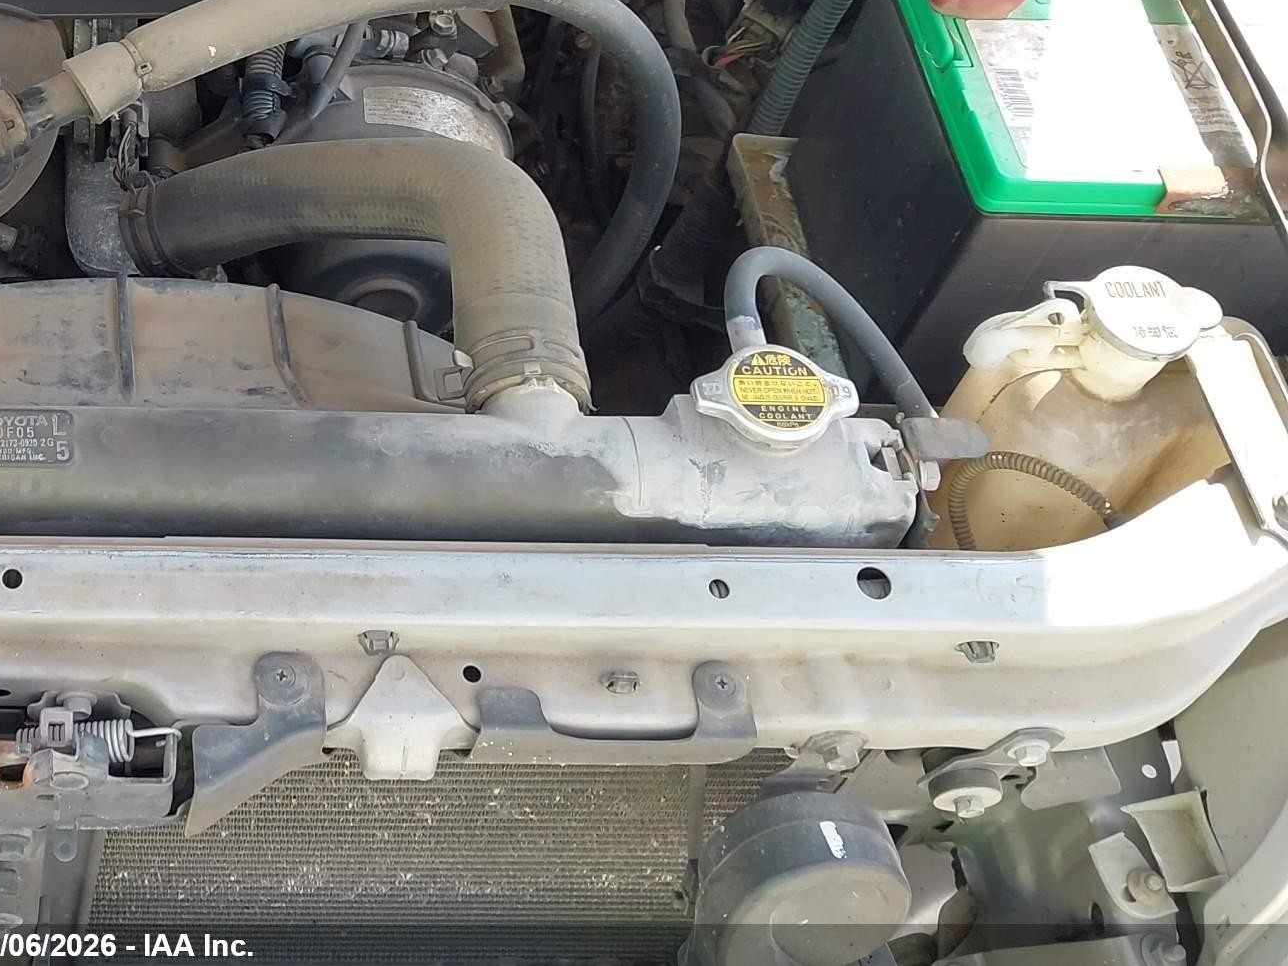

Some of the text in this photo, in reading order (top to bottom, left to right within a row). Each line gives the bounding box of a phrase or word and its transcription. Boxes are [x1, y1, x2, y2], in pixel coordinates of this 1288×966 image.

[1104, 281, 1166, 298] COOLANT
[741, 365, 808, 376] CAUTION
[760, 405, 808, 413] ENGINE
[758, 412, 812, 420] COOLANT
